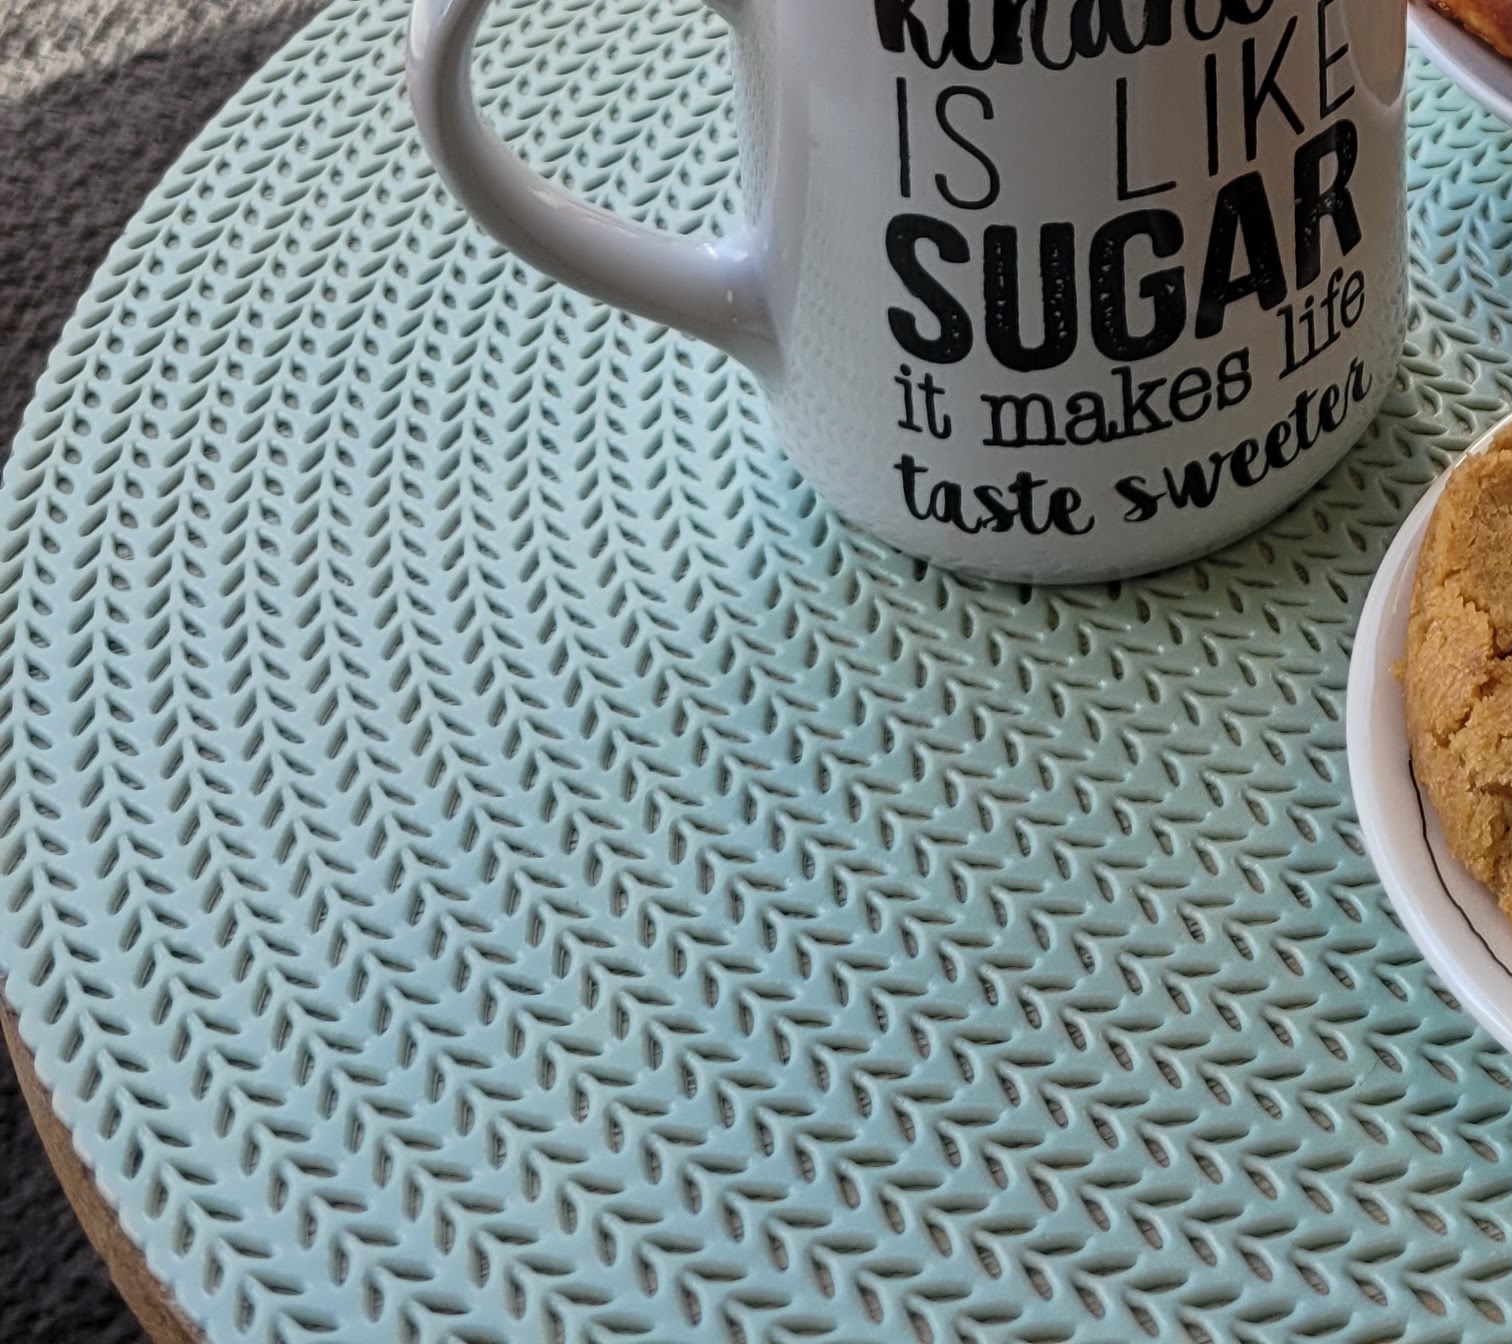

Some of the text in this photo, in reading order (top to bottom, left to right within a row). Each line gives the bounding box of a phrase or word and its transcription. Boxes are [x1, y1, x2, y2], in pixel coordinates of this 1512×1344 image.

[896, 77, 999, 209] IS
[886, 118, 1361, 372] SUGAR
[895, 268, 1366, 447] it makes life
[895, 357, 1371, 534] taste sweeter
